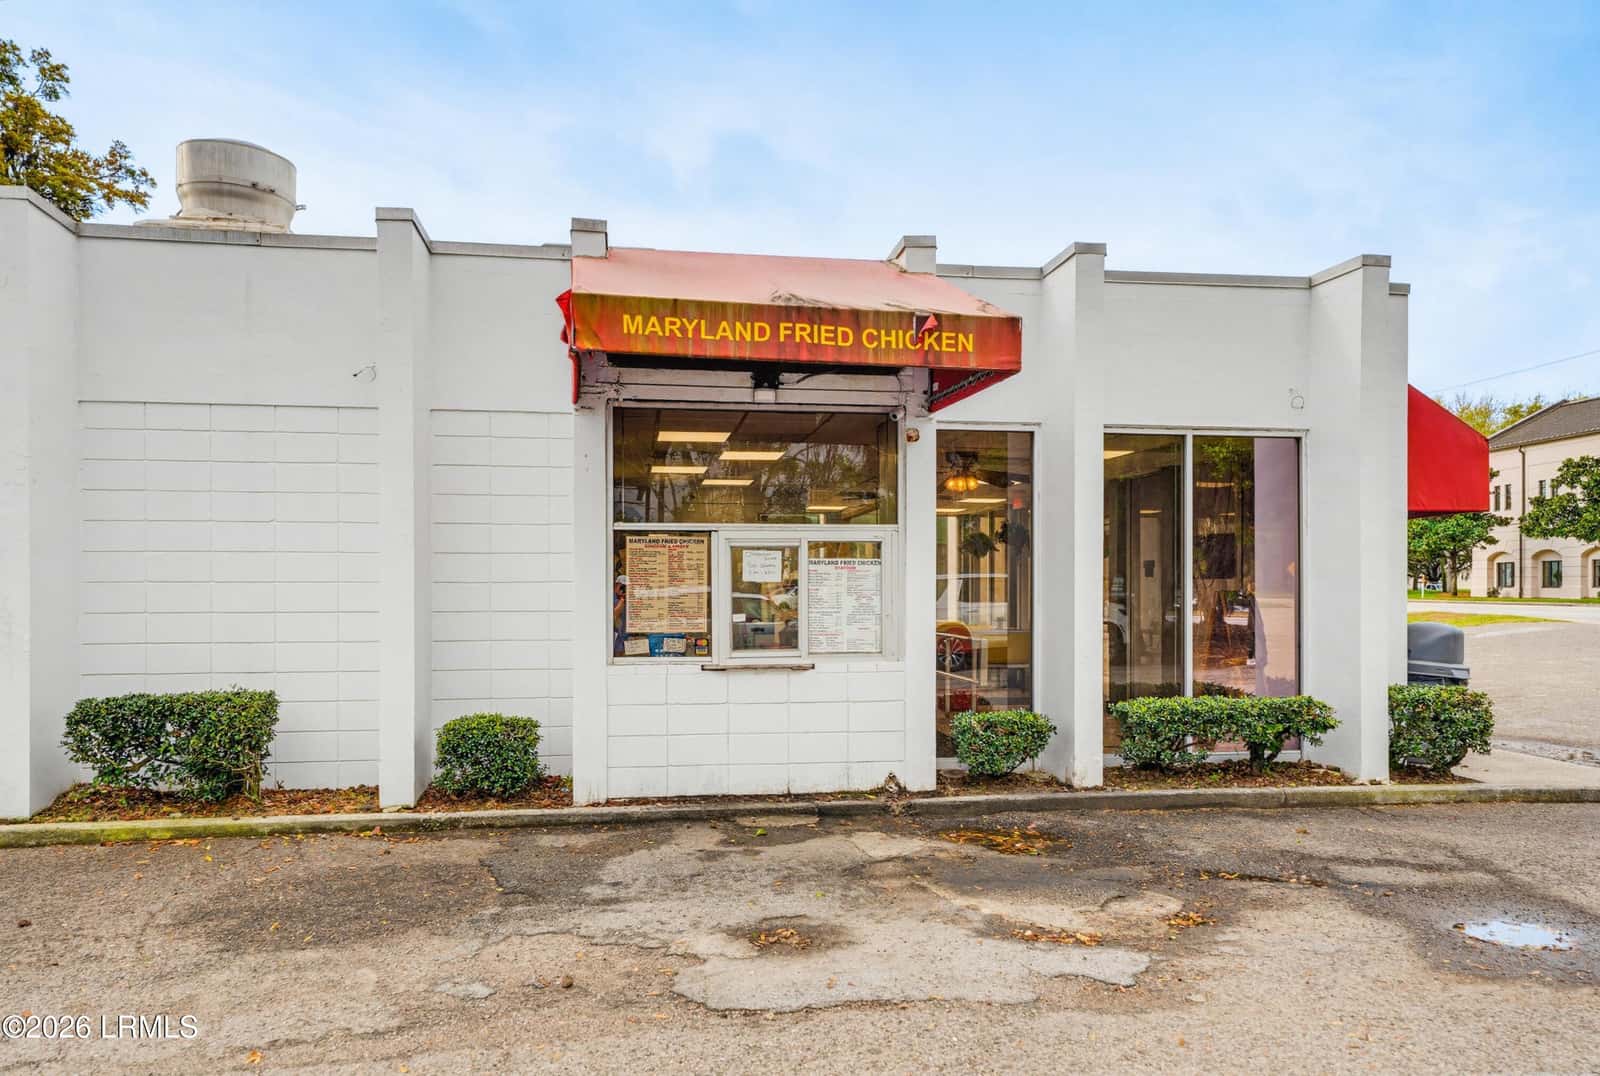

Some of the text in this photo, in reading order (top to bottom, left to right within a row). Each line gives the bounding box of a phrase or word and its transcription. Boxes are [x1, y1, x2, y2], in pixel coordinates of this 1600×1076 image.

[622, 314, 975, 354] MARYLAND FRIED CHICKEN
